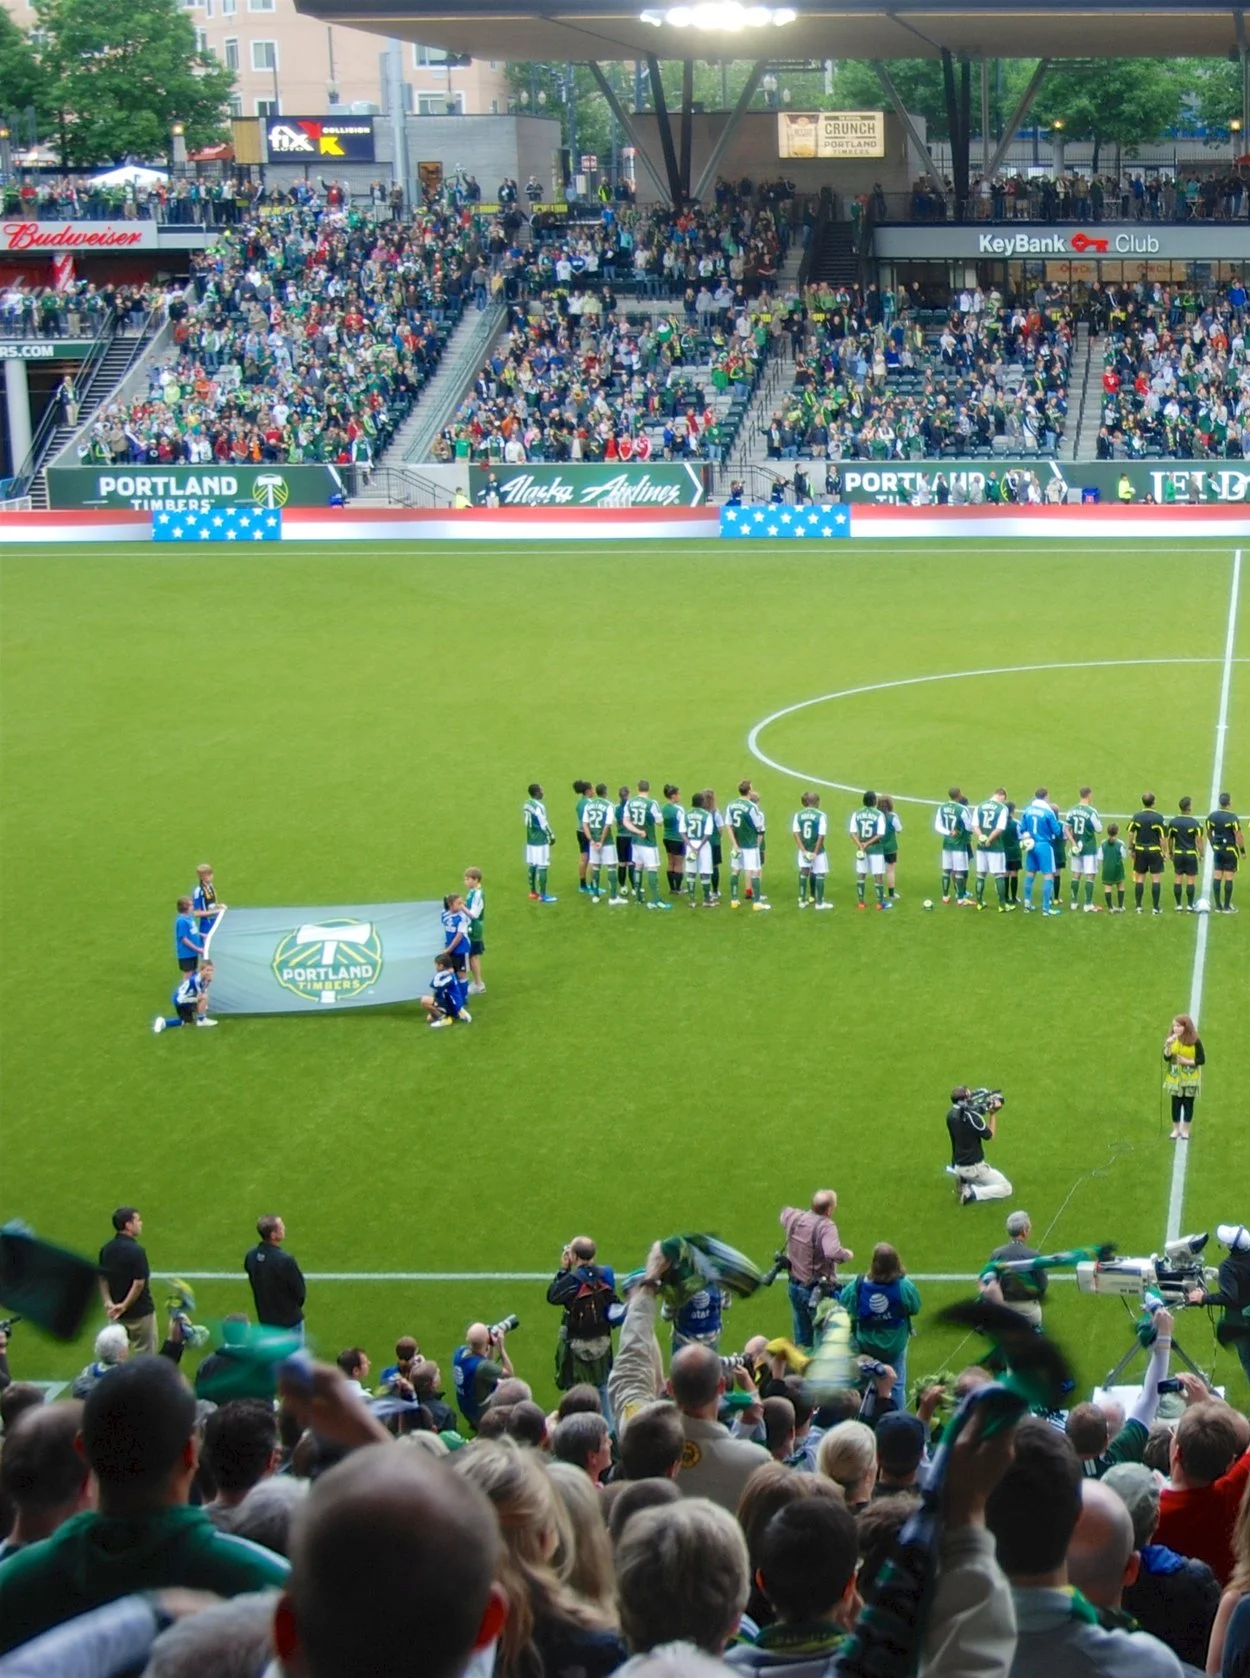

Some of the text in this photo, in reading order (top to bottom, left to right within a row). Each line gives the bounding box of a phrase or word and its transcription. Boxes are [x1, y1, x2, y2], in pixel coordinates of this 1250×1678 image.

[322, 126, 372, 135] COLLISION
[824, 122, 875, 135] CRUNCH
[3, 223, 142, 249] Budweiser
[979, 233, 1160, 256] KeyBank Club
[99, 476, 238, 496] PORTLAND
[589, 810, 602, 828] 22
[631, 808, 645, 826] 33
[733, 810, 742, 828] 5
[943, 814, 957, 833] 17
[982, 810, 994, 828] 12
[1073, 816, 1085, 834] 13
[688, 820, 701, 838] 21
[803, 821, 812, 839] 6
[860, 821, 874, 838] 15
[282, 965, 373, 980] PORTLAND
[297, 979, 361, 990] TIMBERS
